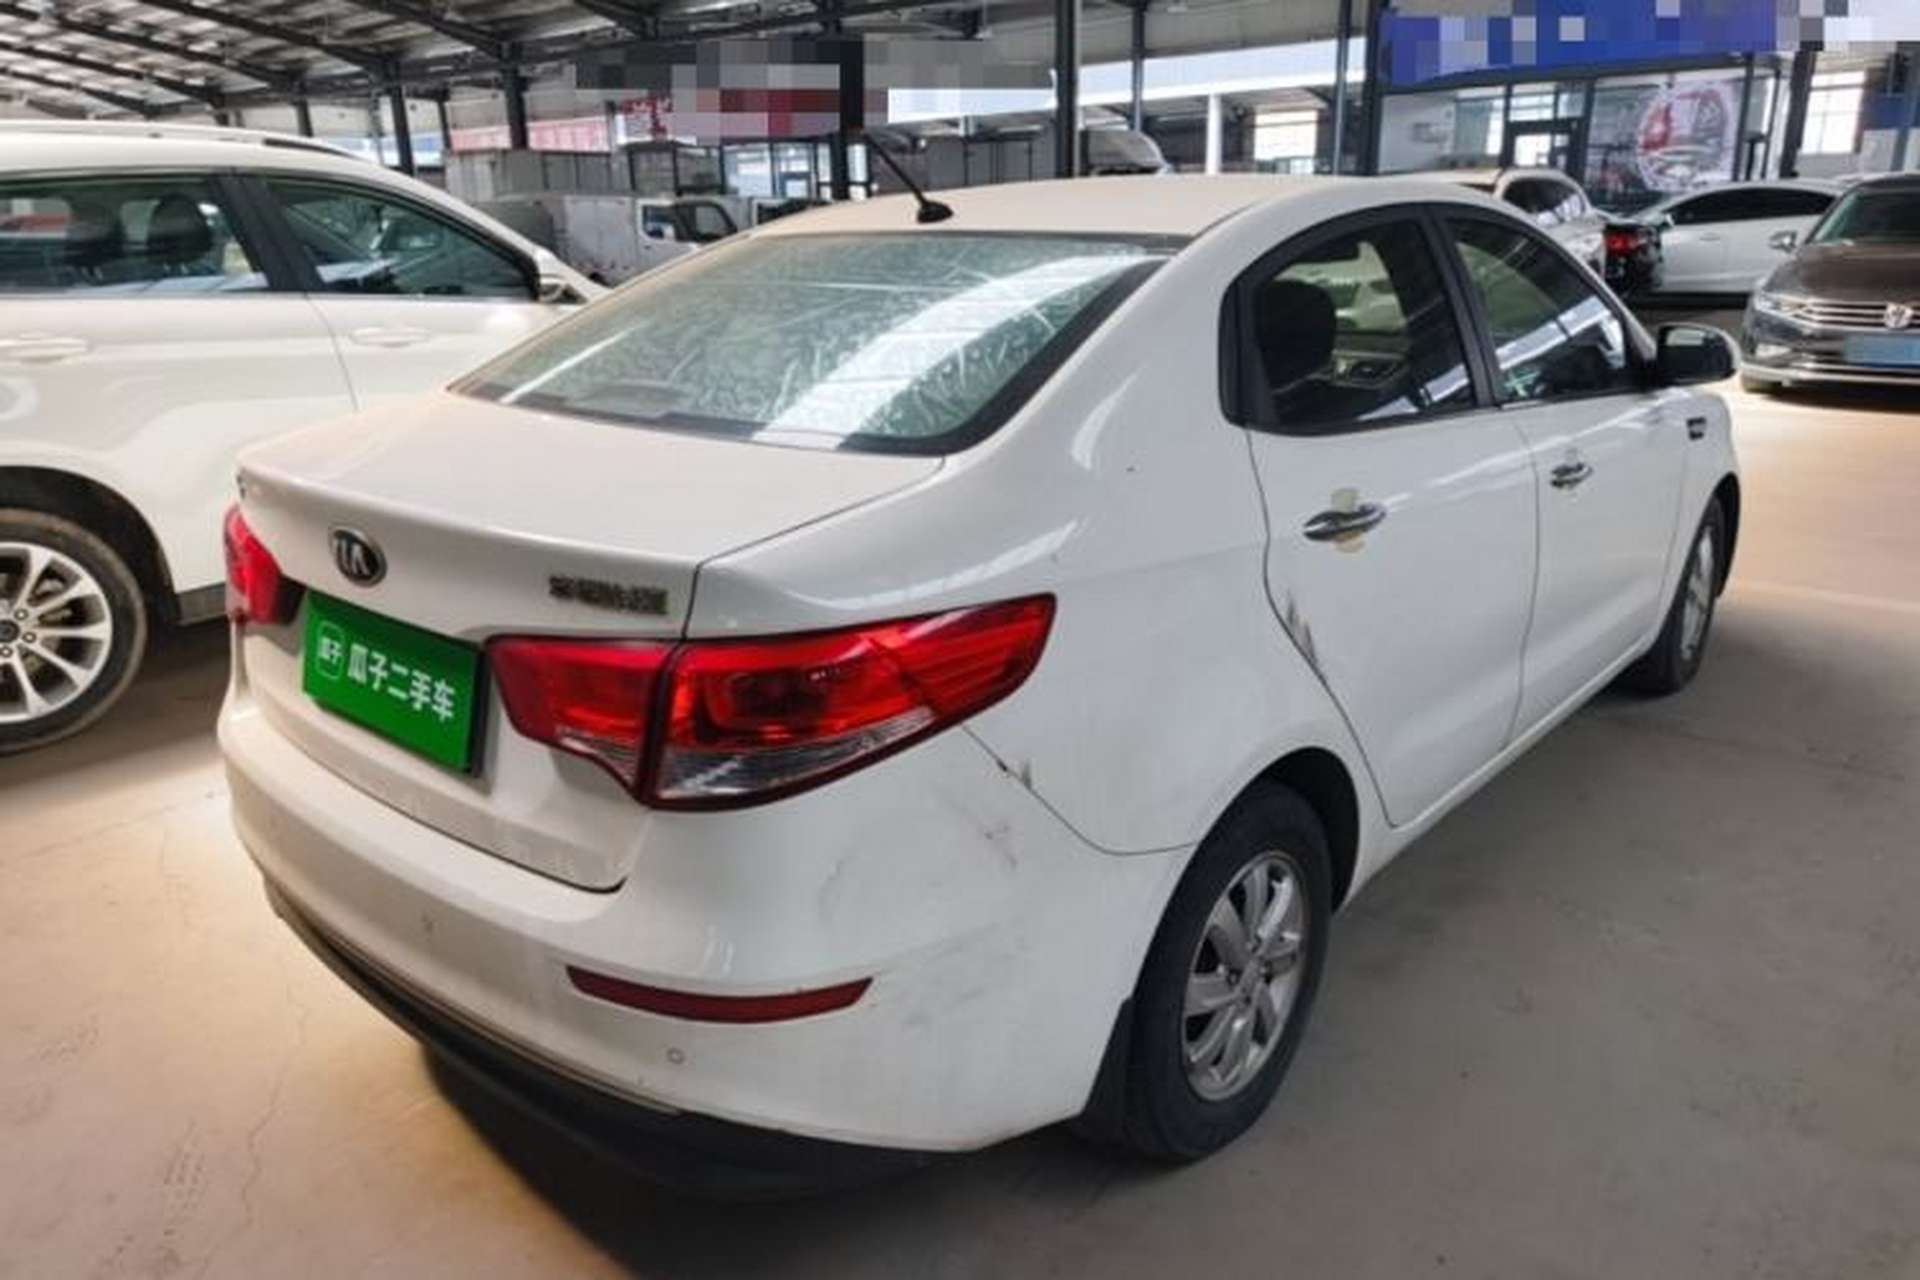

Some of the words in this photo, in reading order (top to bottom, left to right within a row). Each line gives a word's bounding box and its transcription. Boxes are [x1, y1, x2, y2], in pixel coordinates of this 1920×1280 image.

[347, 642, 456, 723] 瓜子二手车
